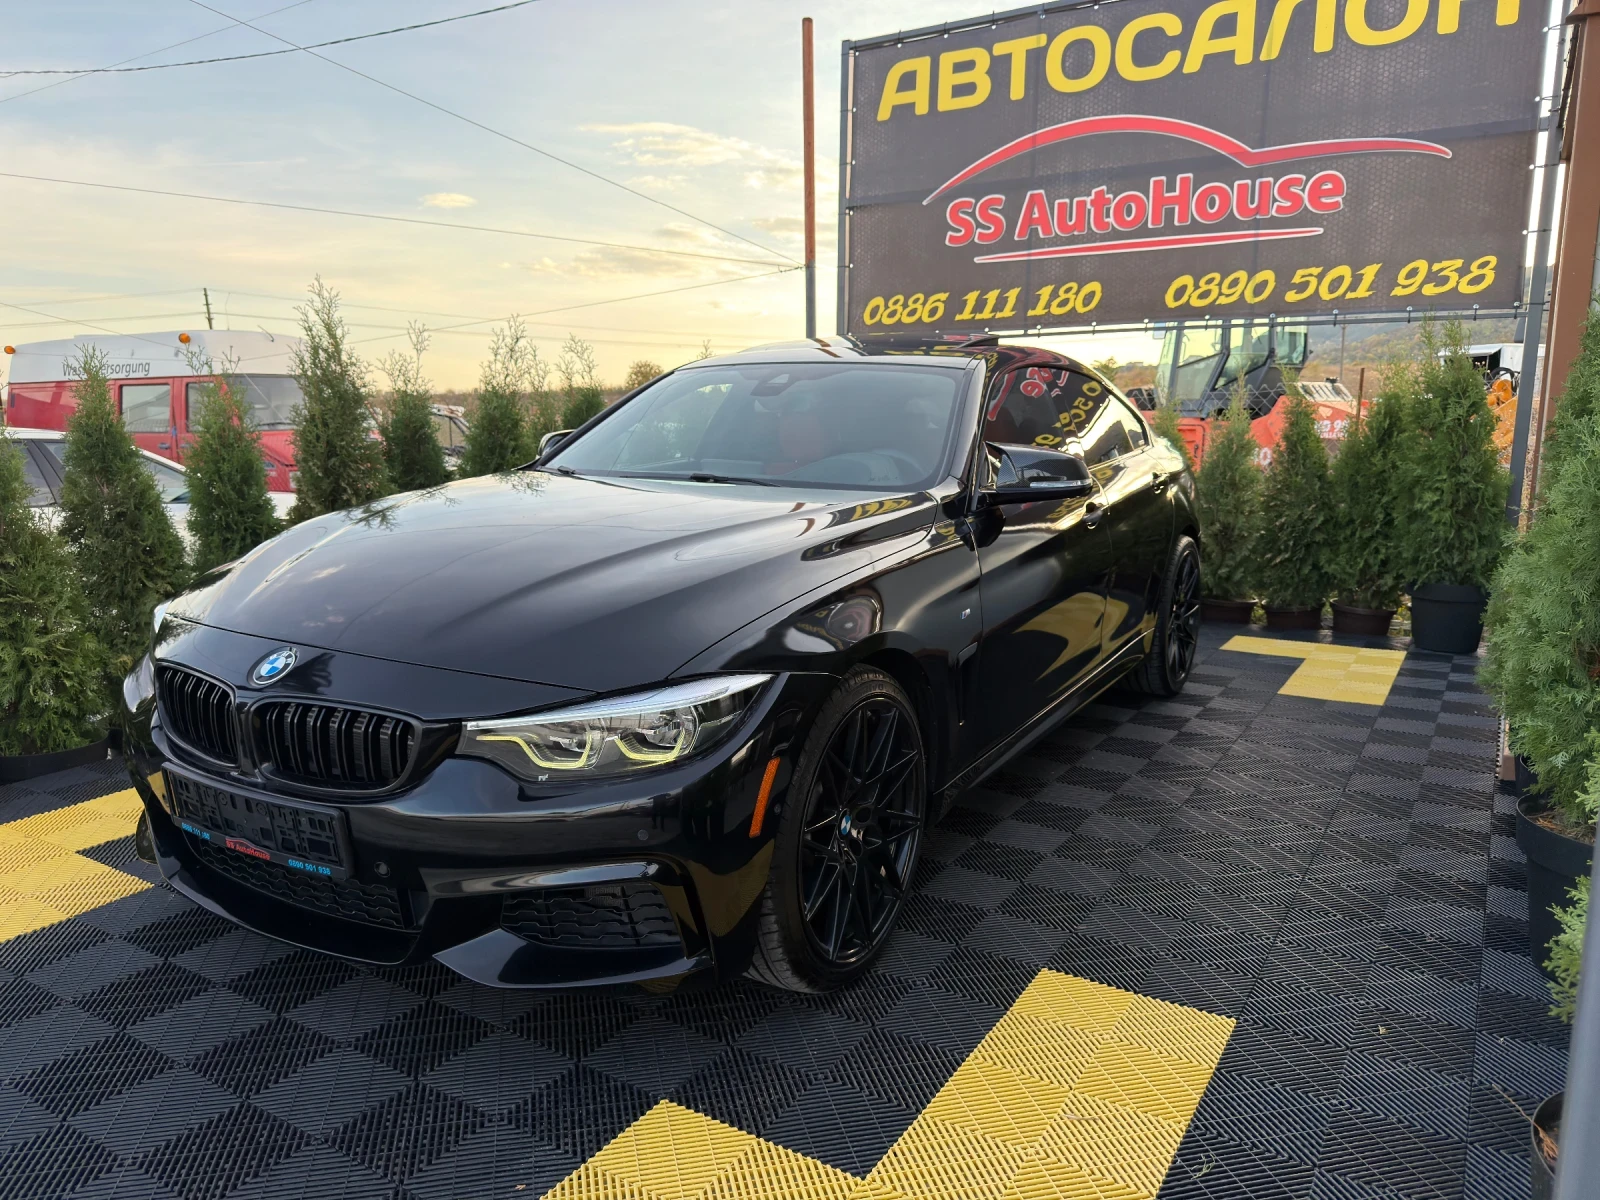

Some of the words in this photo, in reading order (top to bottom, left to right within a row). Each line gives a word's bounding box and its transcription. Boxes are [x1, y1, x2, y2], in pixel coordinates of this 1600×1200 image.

[945, 193, 1006, 247] SS
[1014, 170, 1347, 240] AutoHouse
[863, 292, 950, 326] 0886
[954, 287, 1022, 321] 111
[1027, 281, 1103, 317] 180
[1164, 269, 1276, 309] 0890
[1285, 262, 1383, 303] 501
[1390, 255, 1498, 297] 938
[304, 862, 317, 873] 501
[317, 866, 331, 876] 938
